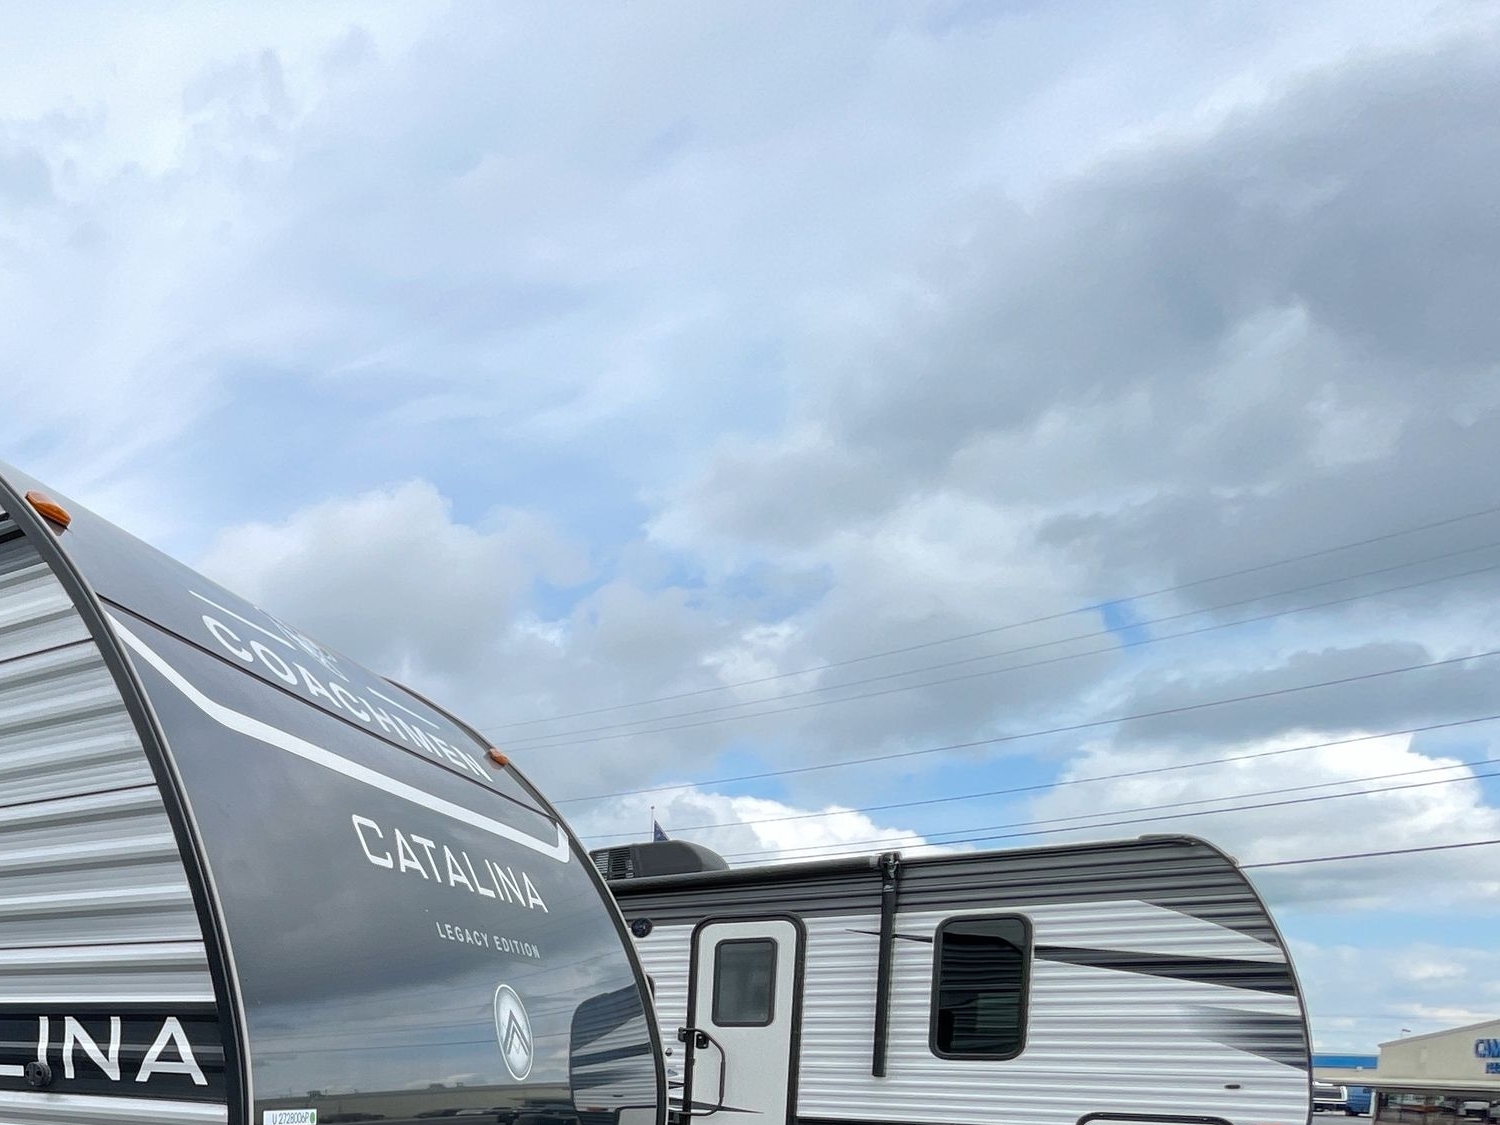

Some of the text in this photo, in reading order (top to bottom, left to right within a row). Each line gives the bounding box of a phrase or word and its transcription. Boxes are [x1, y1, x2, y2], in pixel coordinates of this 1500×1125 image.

[202, 615, 494, 783] COACHMEN
[352, 814, 549, 914] CATALINA
[436, 921, 541, 959] LEGACY EDITION
